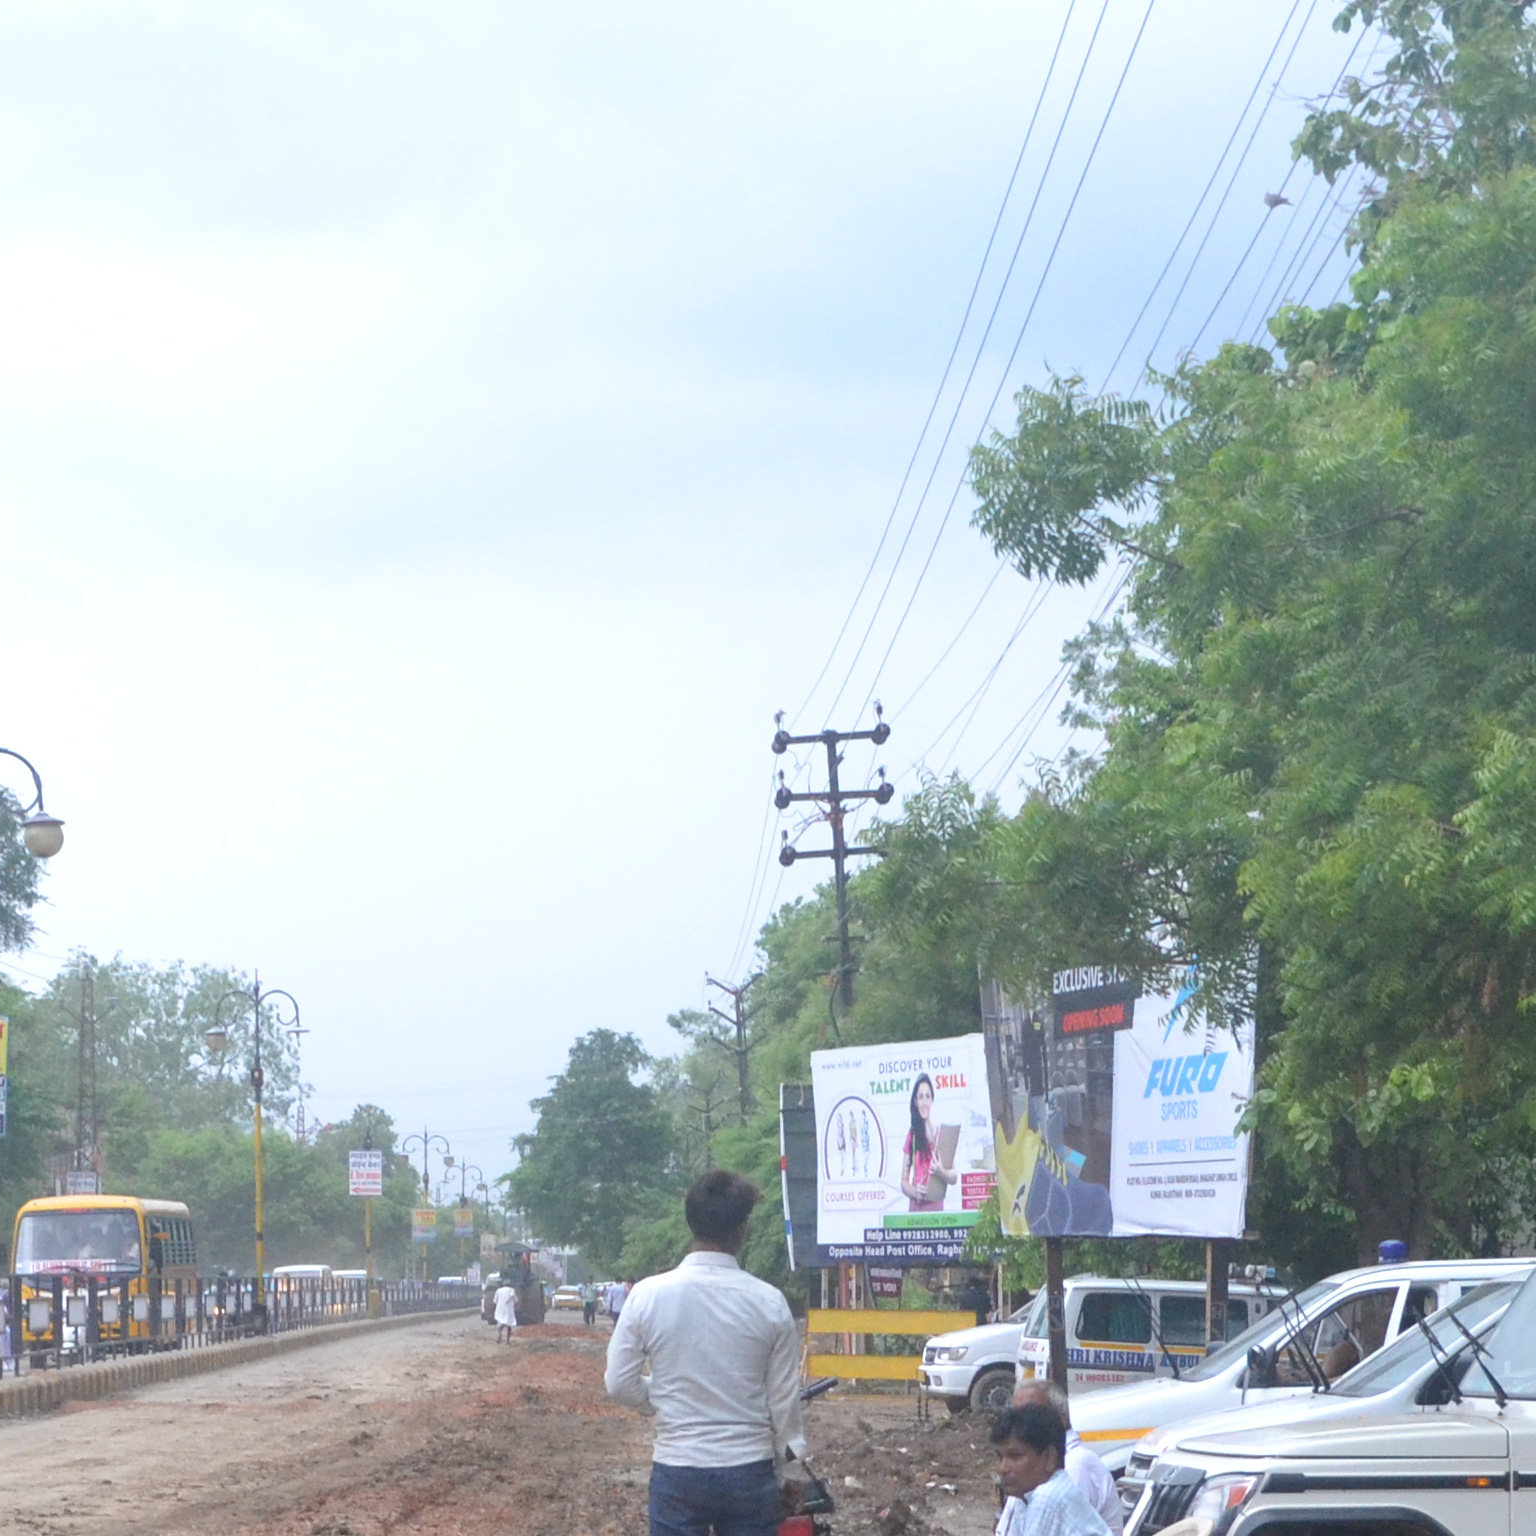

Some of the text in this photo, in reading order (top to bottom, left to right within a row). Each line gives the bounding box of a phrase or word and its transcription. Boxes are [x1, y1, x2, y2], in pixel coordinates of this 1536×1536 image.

[1053, 966, 1104, 994] EXCLUSIVE
[879, 1056, 953, 1074] DISCOVER YOUR
[870, 1073, 967, 1095] TALENT SKILL
[1144, 1052, 1228, 1098] FURO
[1161, 1100, 1198, 1121] SPORTS
[825, 1190, 886, 1202] COURSES OFFERED
[866, 1231, 884, 1242] Help
[885, 1230, 902, 1240] Line
[829, 1245, 863, 1259] Opposite
[865, 1245, 886, 1257] Head
[887, 1245, 906, 1257] Post
[908, 1245, 935, 1257] Office,
[1094, 1351, 1154, 1368] KRISHNA
